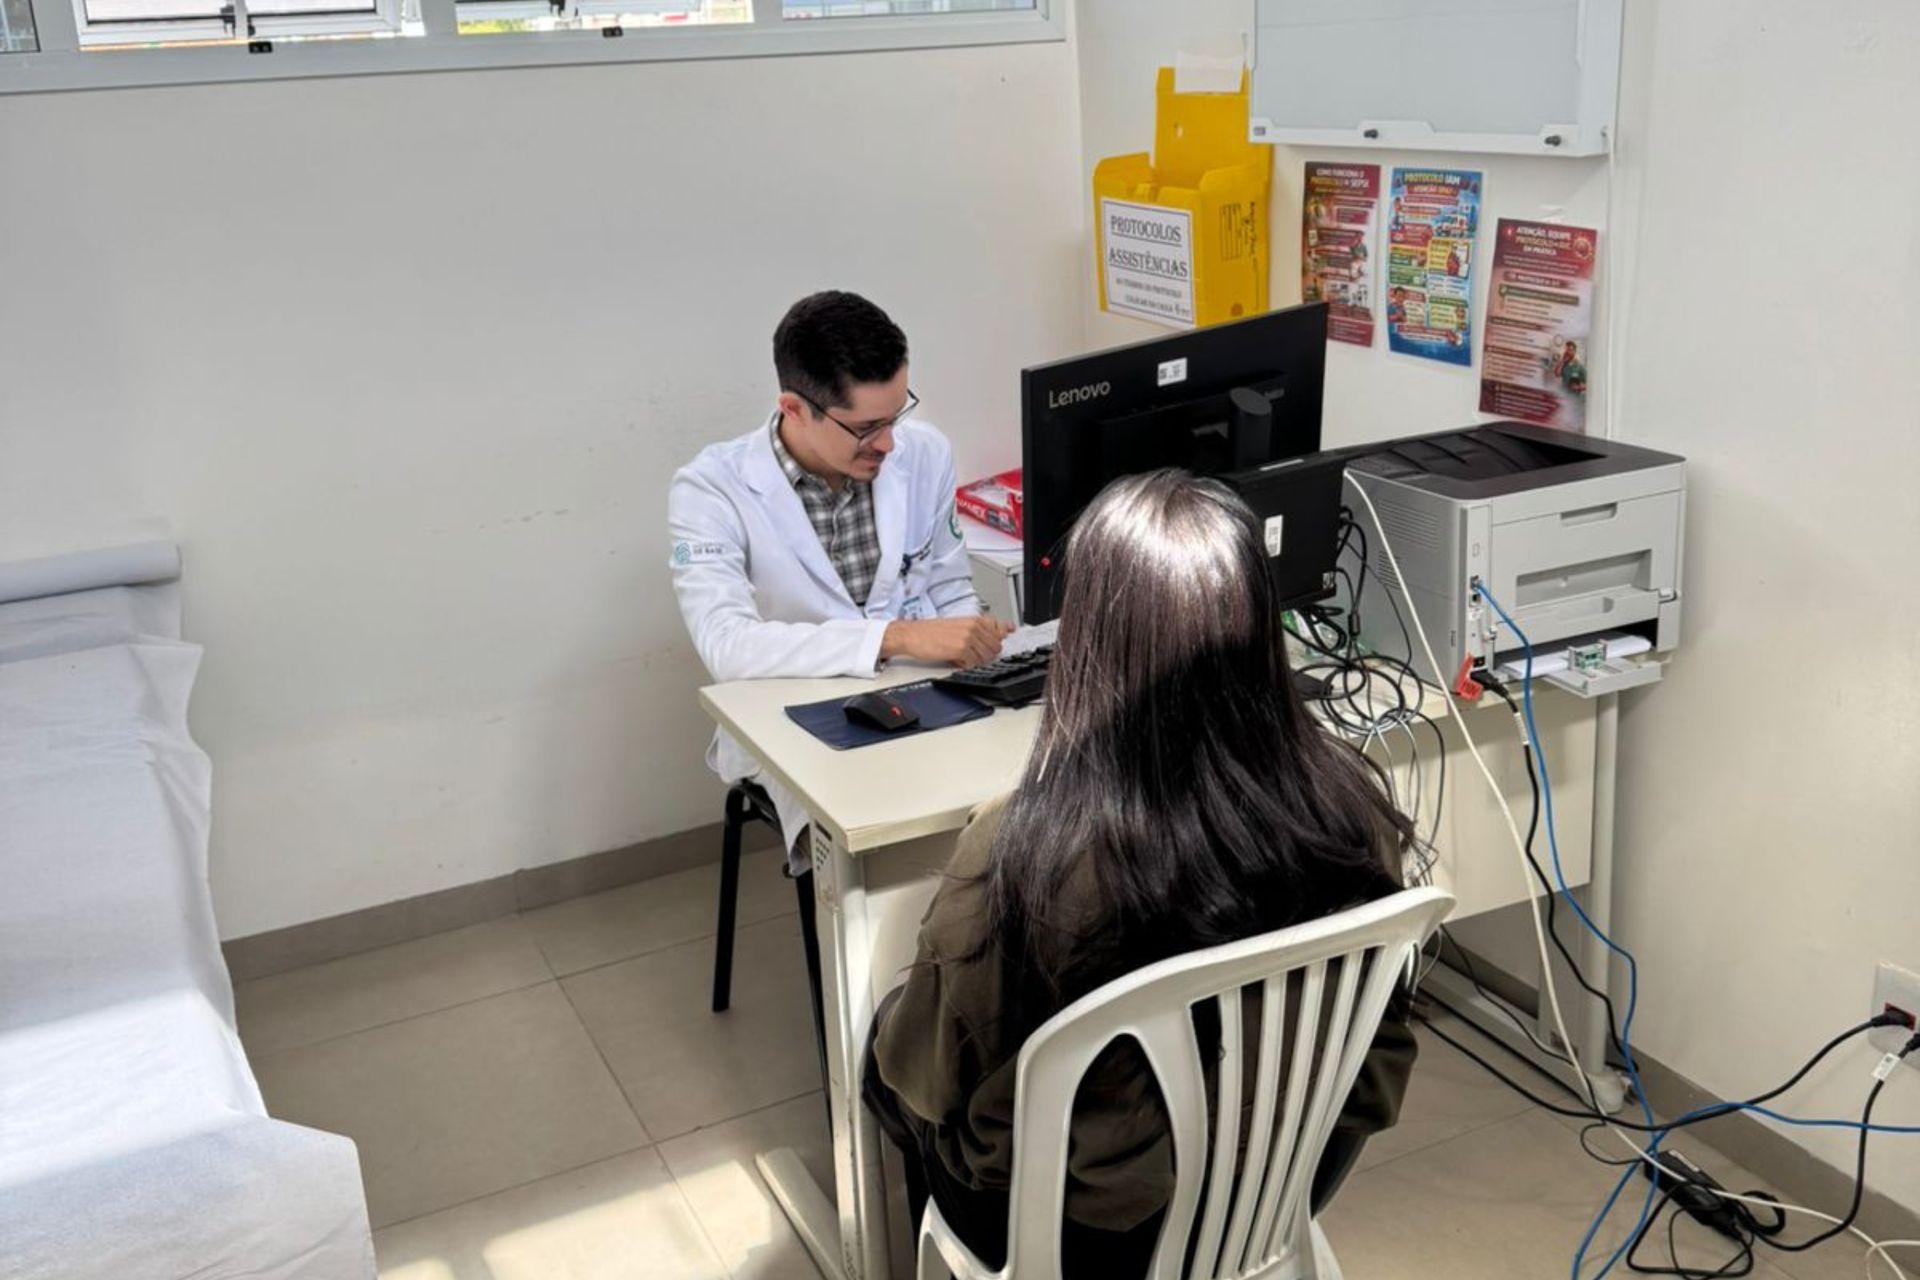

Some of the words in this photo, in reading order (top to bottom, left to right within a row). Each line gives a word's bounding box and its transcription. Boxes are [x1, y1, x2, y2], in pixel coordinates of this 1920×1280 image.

[1111, 215, 1182, 243] PROTOCOLOS
[1109, 247, 1188, 278] ASSISTÊNCIAS
[1049, 381, 1112, 409] Lenovo
